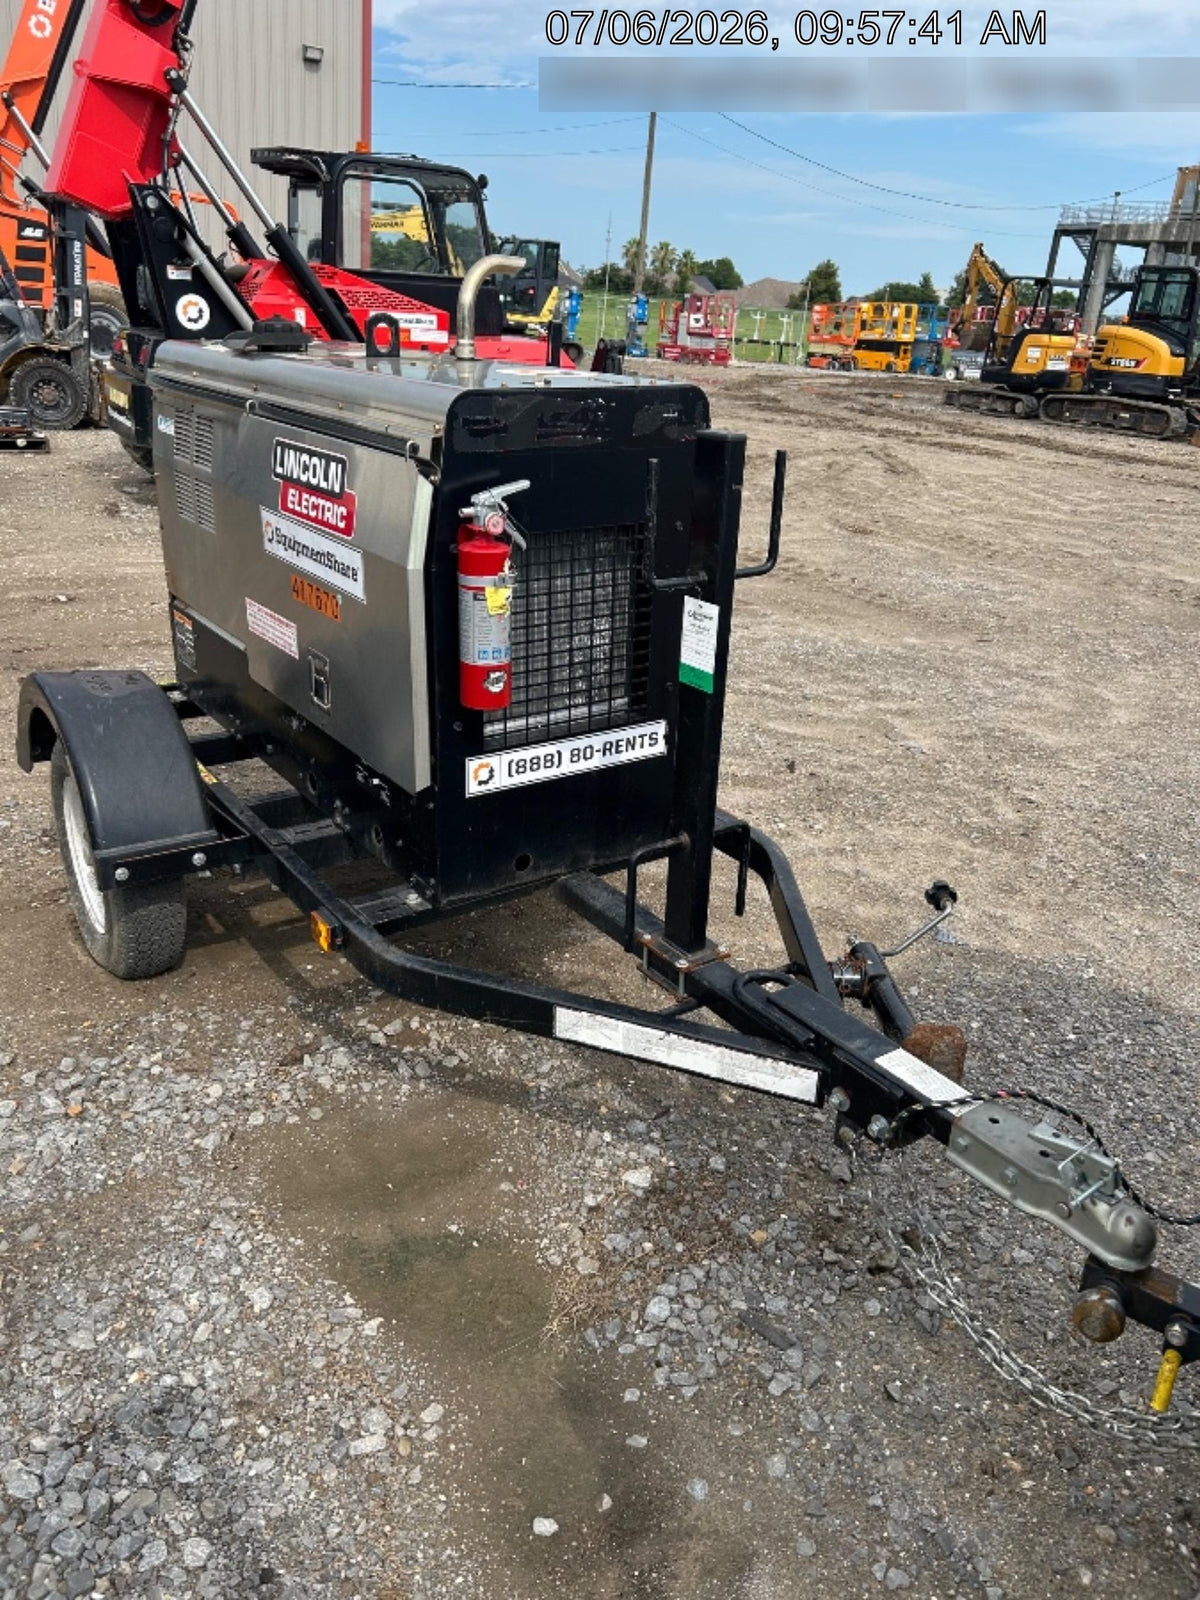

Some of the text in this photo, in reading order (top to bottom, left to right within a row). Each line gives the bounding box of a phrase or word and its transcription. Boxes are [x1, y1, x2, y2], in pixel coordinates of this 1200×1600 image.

[21, 226, 44, 237] JLG
[275, 446, 342, 493] LINCOLN
[287, 489, 348, 529] ELECTRIC
[274, 528, 359, 583] EquipmentShare
[291, 577, 340, 620] 417670
[506, 732, 659, 778] (888) 80-RENTS
